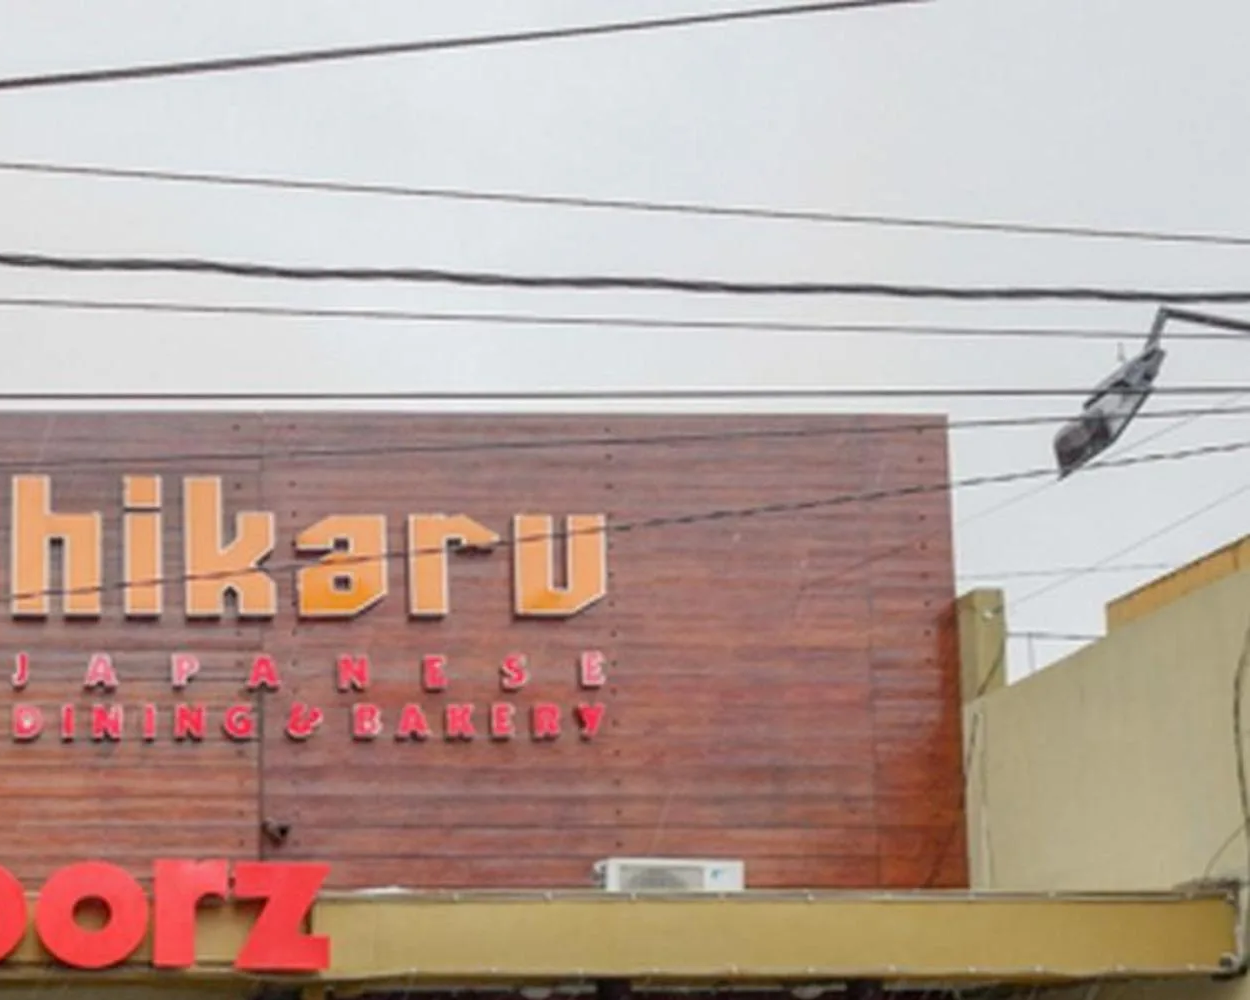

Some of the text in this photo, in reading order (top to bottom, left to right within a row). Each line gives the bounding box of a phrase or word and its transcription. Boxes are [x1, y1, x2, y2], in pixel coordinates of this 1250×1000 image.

[10, 474, 609, 619] hikaru
[12, 651, 607, 690] JAPANESE
[12, 703, 605, 741] DINING & BAKERY
